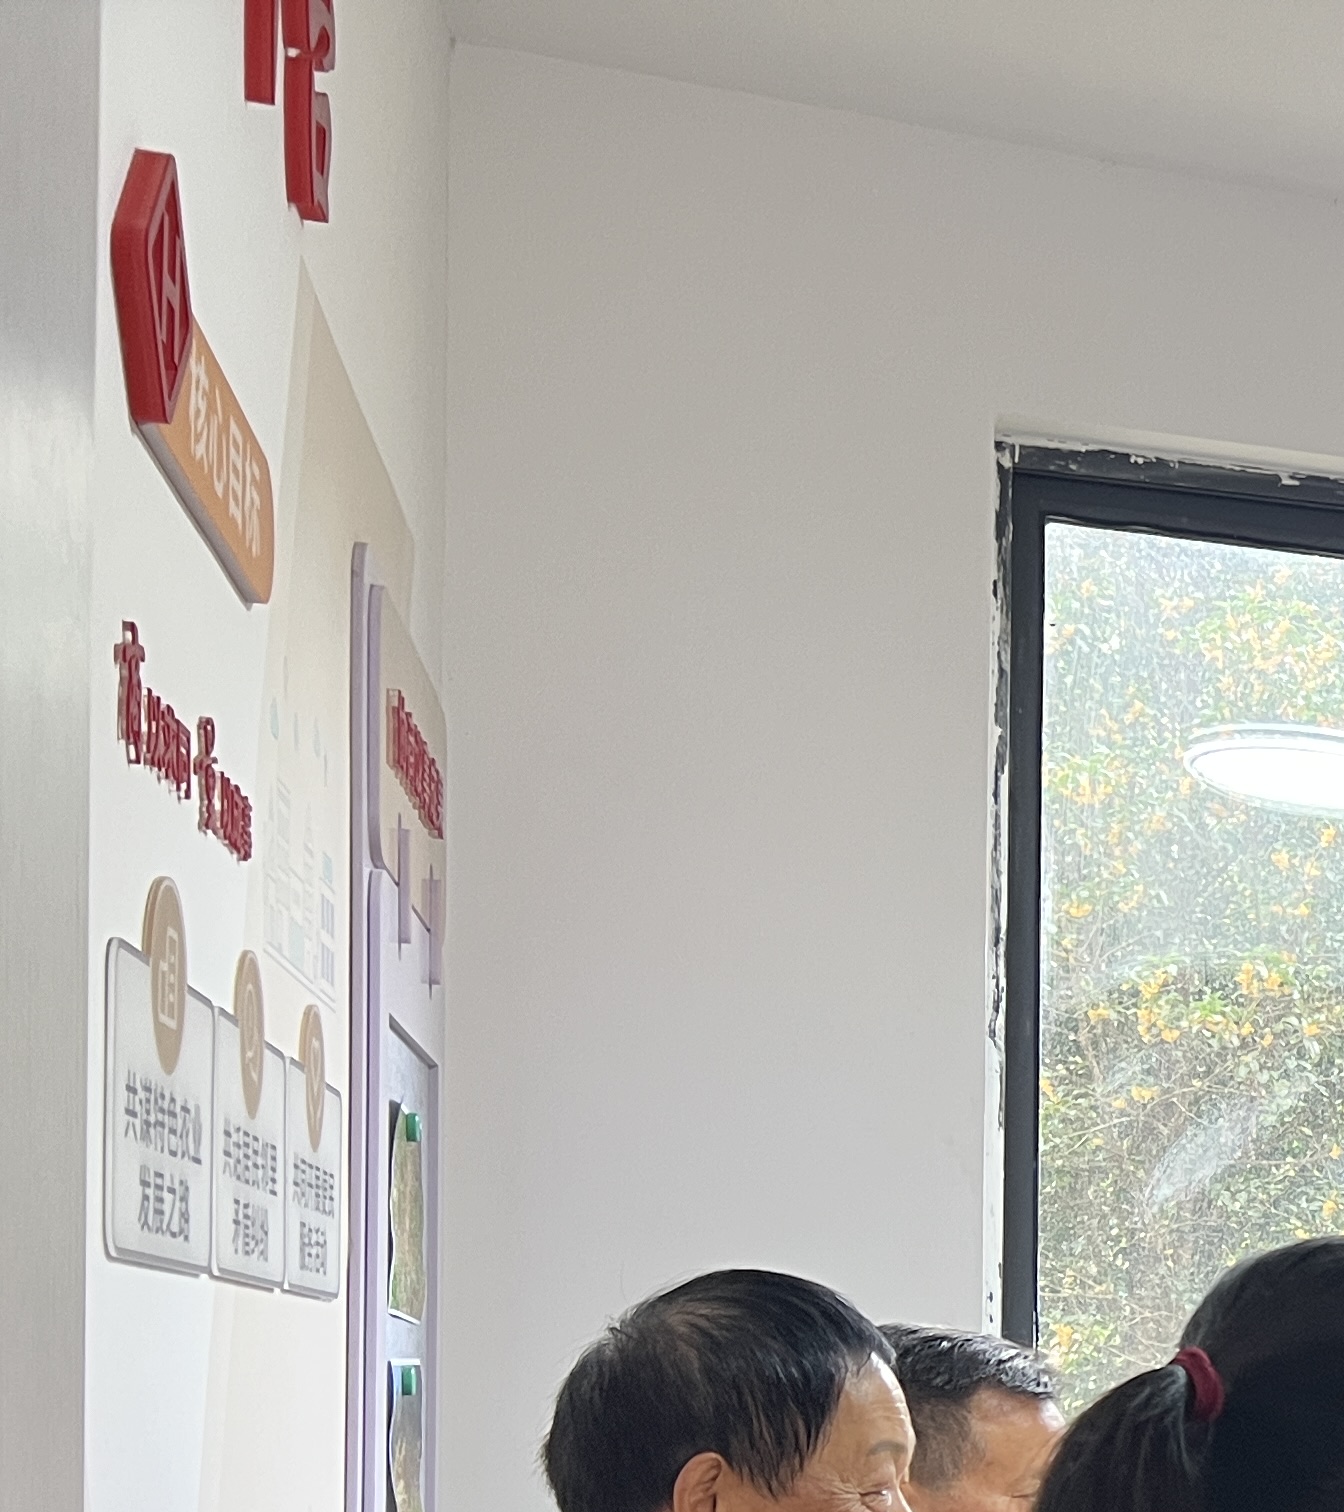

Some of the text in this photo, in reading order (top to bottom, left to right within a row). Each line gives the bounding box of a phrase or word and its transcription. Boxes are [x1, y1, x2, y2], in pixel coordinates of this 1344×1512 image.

[187, 345, 262, 558] 核心目标
[137, 1163, 190, 1243] 发展之路
